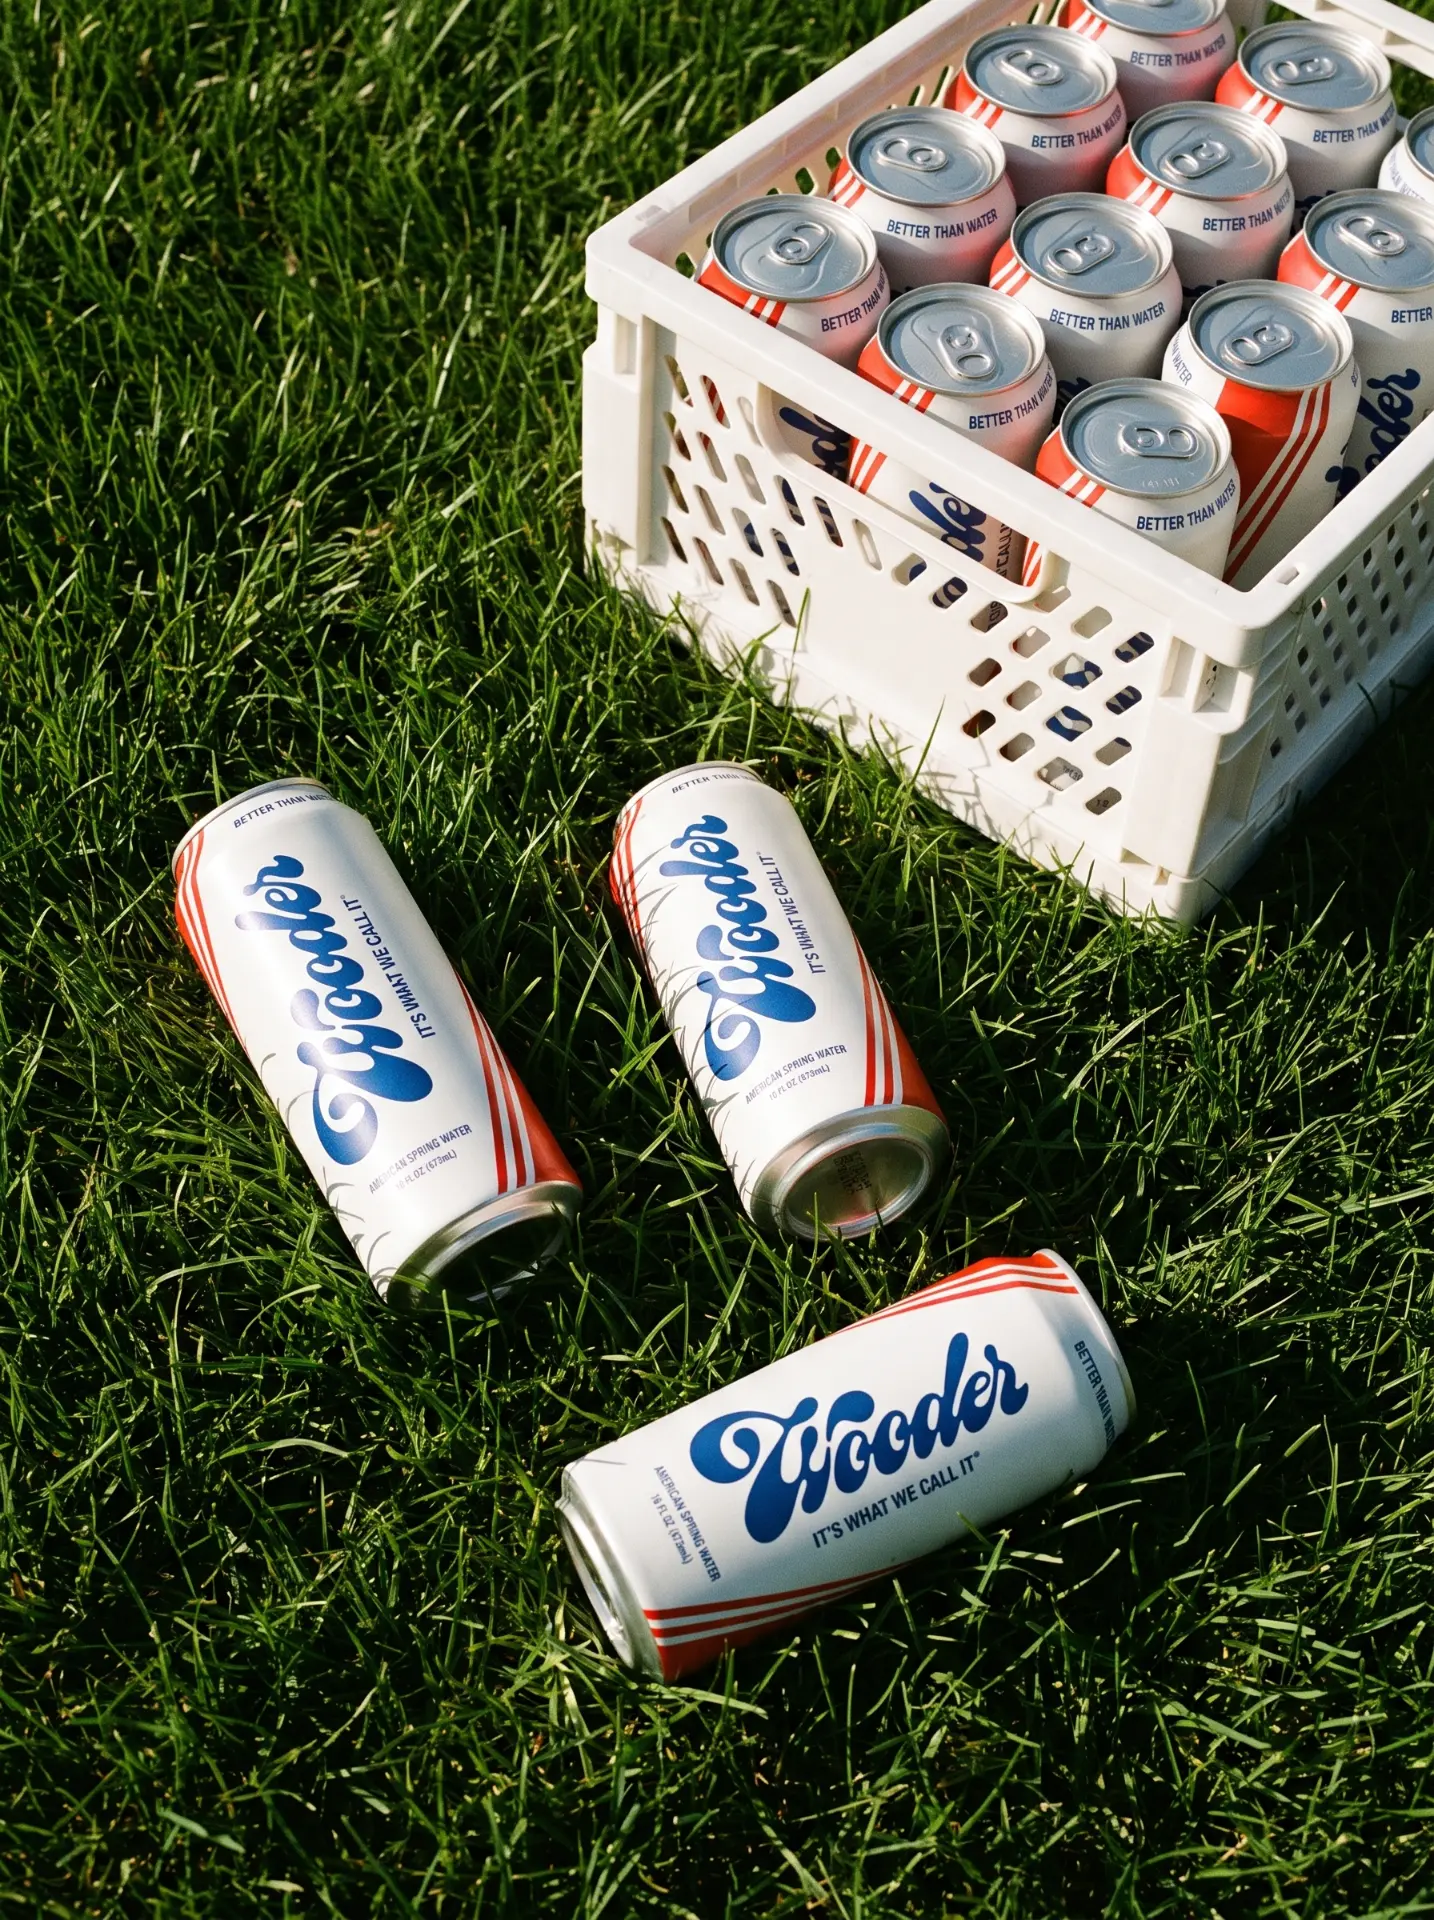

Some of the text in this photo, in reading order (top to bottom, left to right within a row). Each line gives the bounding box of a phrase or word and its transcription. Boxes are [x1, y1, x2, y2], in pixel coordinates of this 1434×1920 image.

[1130, 51, 1172, 66] BETTER
[1174, 49, 1201, 65] THAN
[1031, 134, 1075, 148] BETTER
[1077, 126, 1103, 145] THAN
[1313, 129, 1355, 143] BETTER
[1357, 121, 1379, 139] THAN
[887, 208, 998, 239] BETTER THAN WATER
[1203, 217, 1246, 231] BETTER
[1248, 208, 1273, 228] THAN
[821, 307, 862, 332] BETTER
[861, 288, 881, 315] THAN
[1049, 301, 1166, 331] BETTER THAN WATER
[1391, 306, 1433, 323] BETTER
[1172, 353, 1192, 386] WATER
[969, 410, 1013, 429] BETTER
[1014, 396, 1039, 419] THAN
[1137, 515, 1184, 531] BETTER
[1186, 502, 1215, 526] THAN
[672, 776, 711, 794] BETTER
[233, 803, 275, 829] BETTER
[274, 795, 306, 809] THAN
[766, 867, 789, 896] CALL
[778, 897, 798, 916] WE
[354, 911, 382, 947] CALL
[788, 917, 814, 951] WHAT
[372, 946, 397, 971] WE
[659, 814, 817, 1082] Wooder
[804, 952, 826, 974] IT'S
[385, 972, 420, 1013] WHAT
[235, 854, 433, 1166] Wooder
[410, 1012, 437, 1039] IT'S
[745, 1044, 847, 1105] AMERICAN SPRING WATER
[786, 1077, 798, 1089] OZ
[368, 1123, 473, 1194] AMERICAN SPRING WATER
[413, 1166, 426, 1179] OZ
[1074, 1340, 1103, 1389] BETTER
[689, 1332, 1030, 1544] Wooder
[656, 1503, 669, 1517] FL
[662, 1513, 676, 1529] OZ
[812, 1522, 844, 1549] IT'S
[843, 1497, 889, 1532] WHAT
[890, 1484, 918, 1509] WE
[919, 1466, 959, 1496] CALL
[654, 1465, 722, 1582] AMERICAN SPRING WATER
